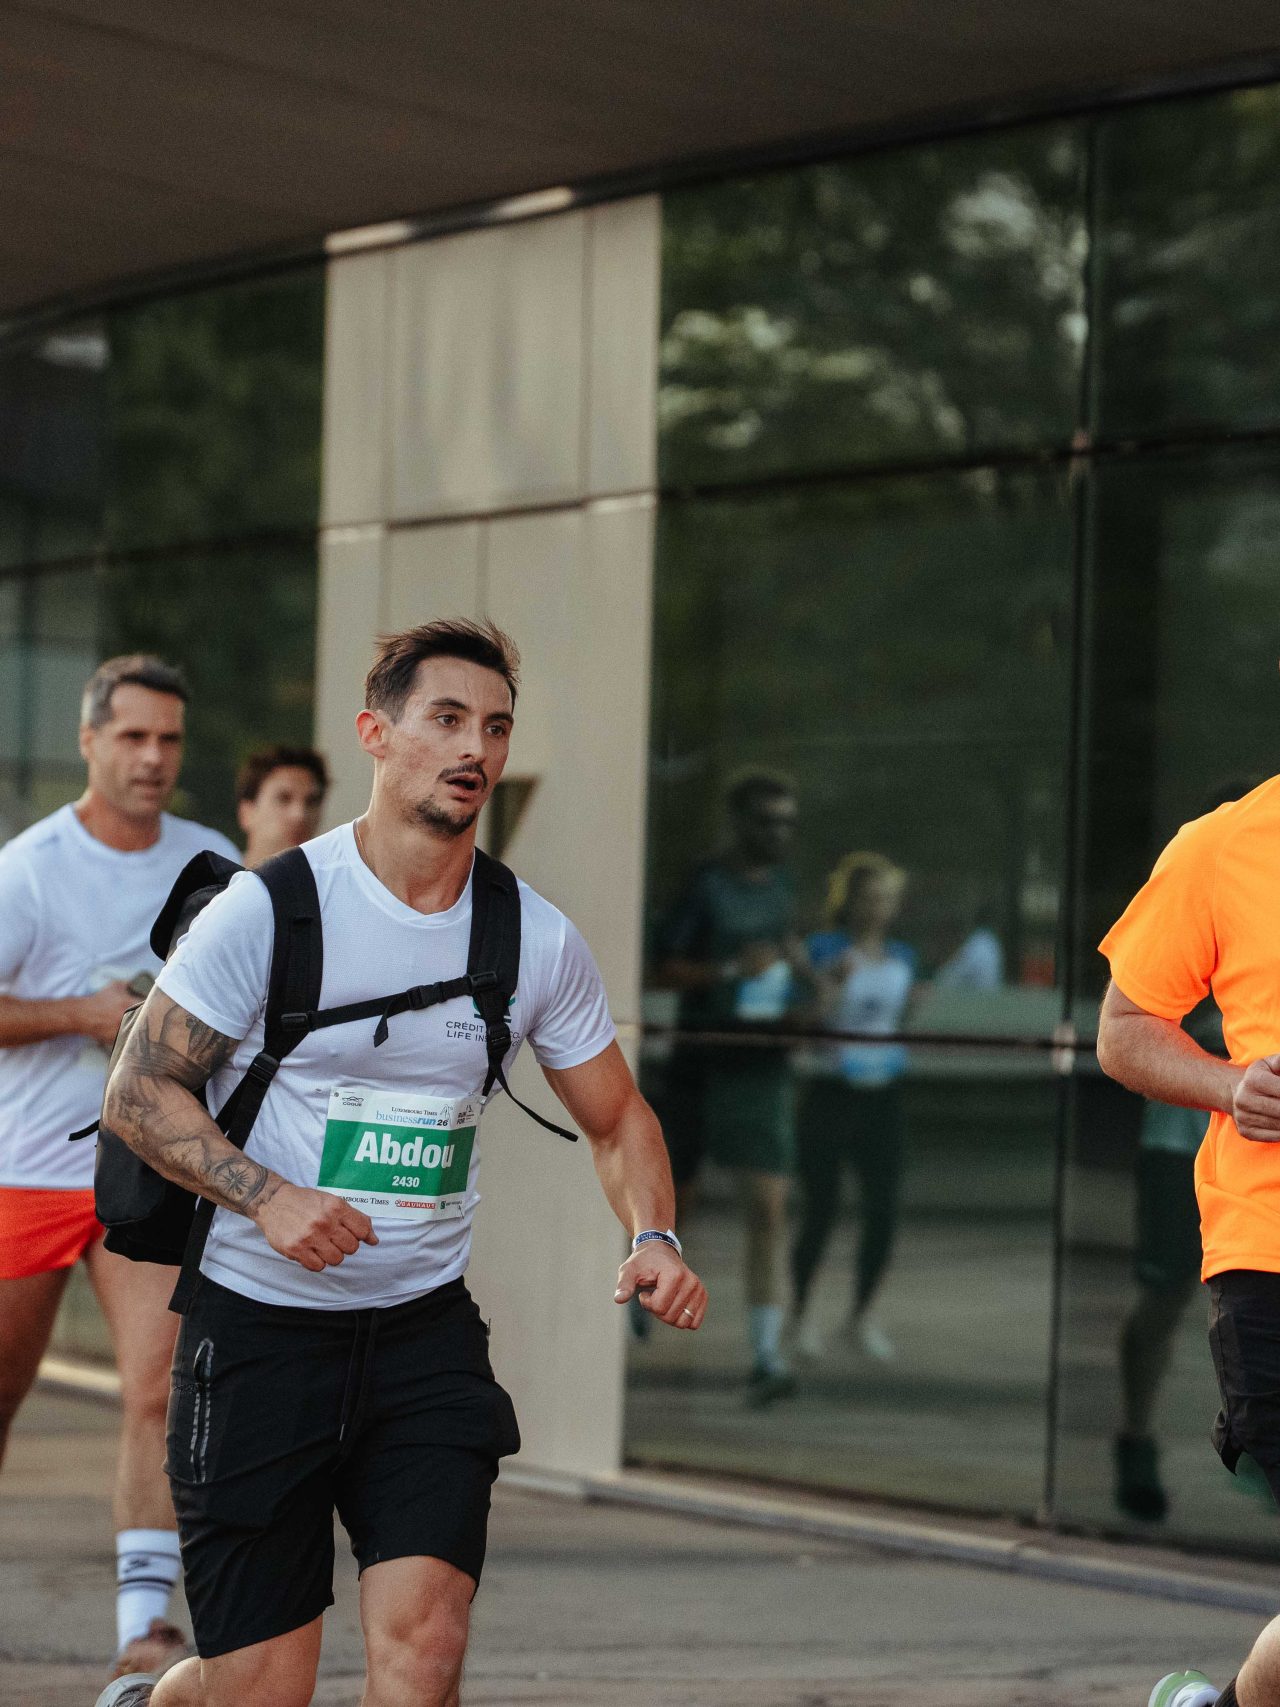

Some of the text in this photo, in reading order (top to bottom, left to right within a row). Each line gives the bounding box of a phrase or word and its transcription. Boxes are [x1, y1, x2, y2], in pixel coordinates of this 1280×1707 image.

[445, 1021, 485, 1033] CRÉDIT
[446, 1030, 472, 1041] LIFE
[354, 1131, 456, 1169] Abdou
[391, 1175, 421, 1188] 2430
